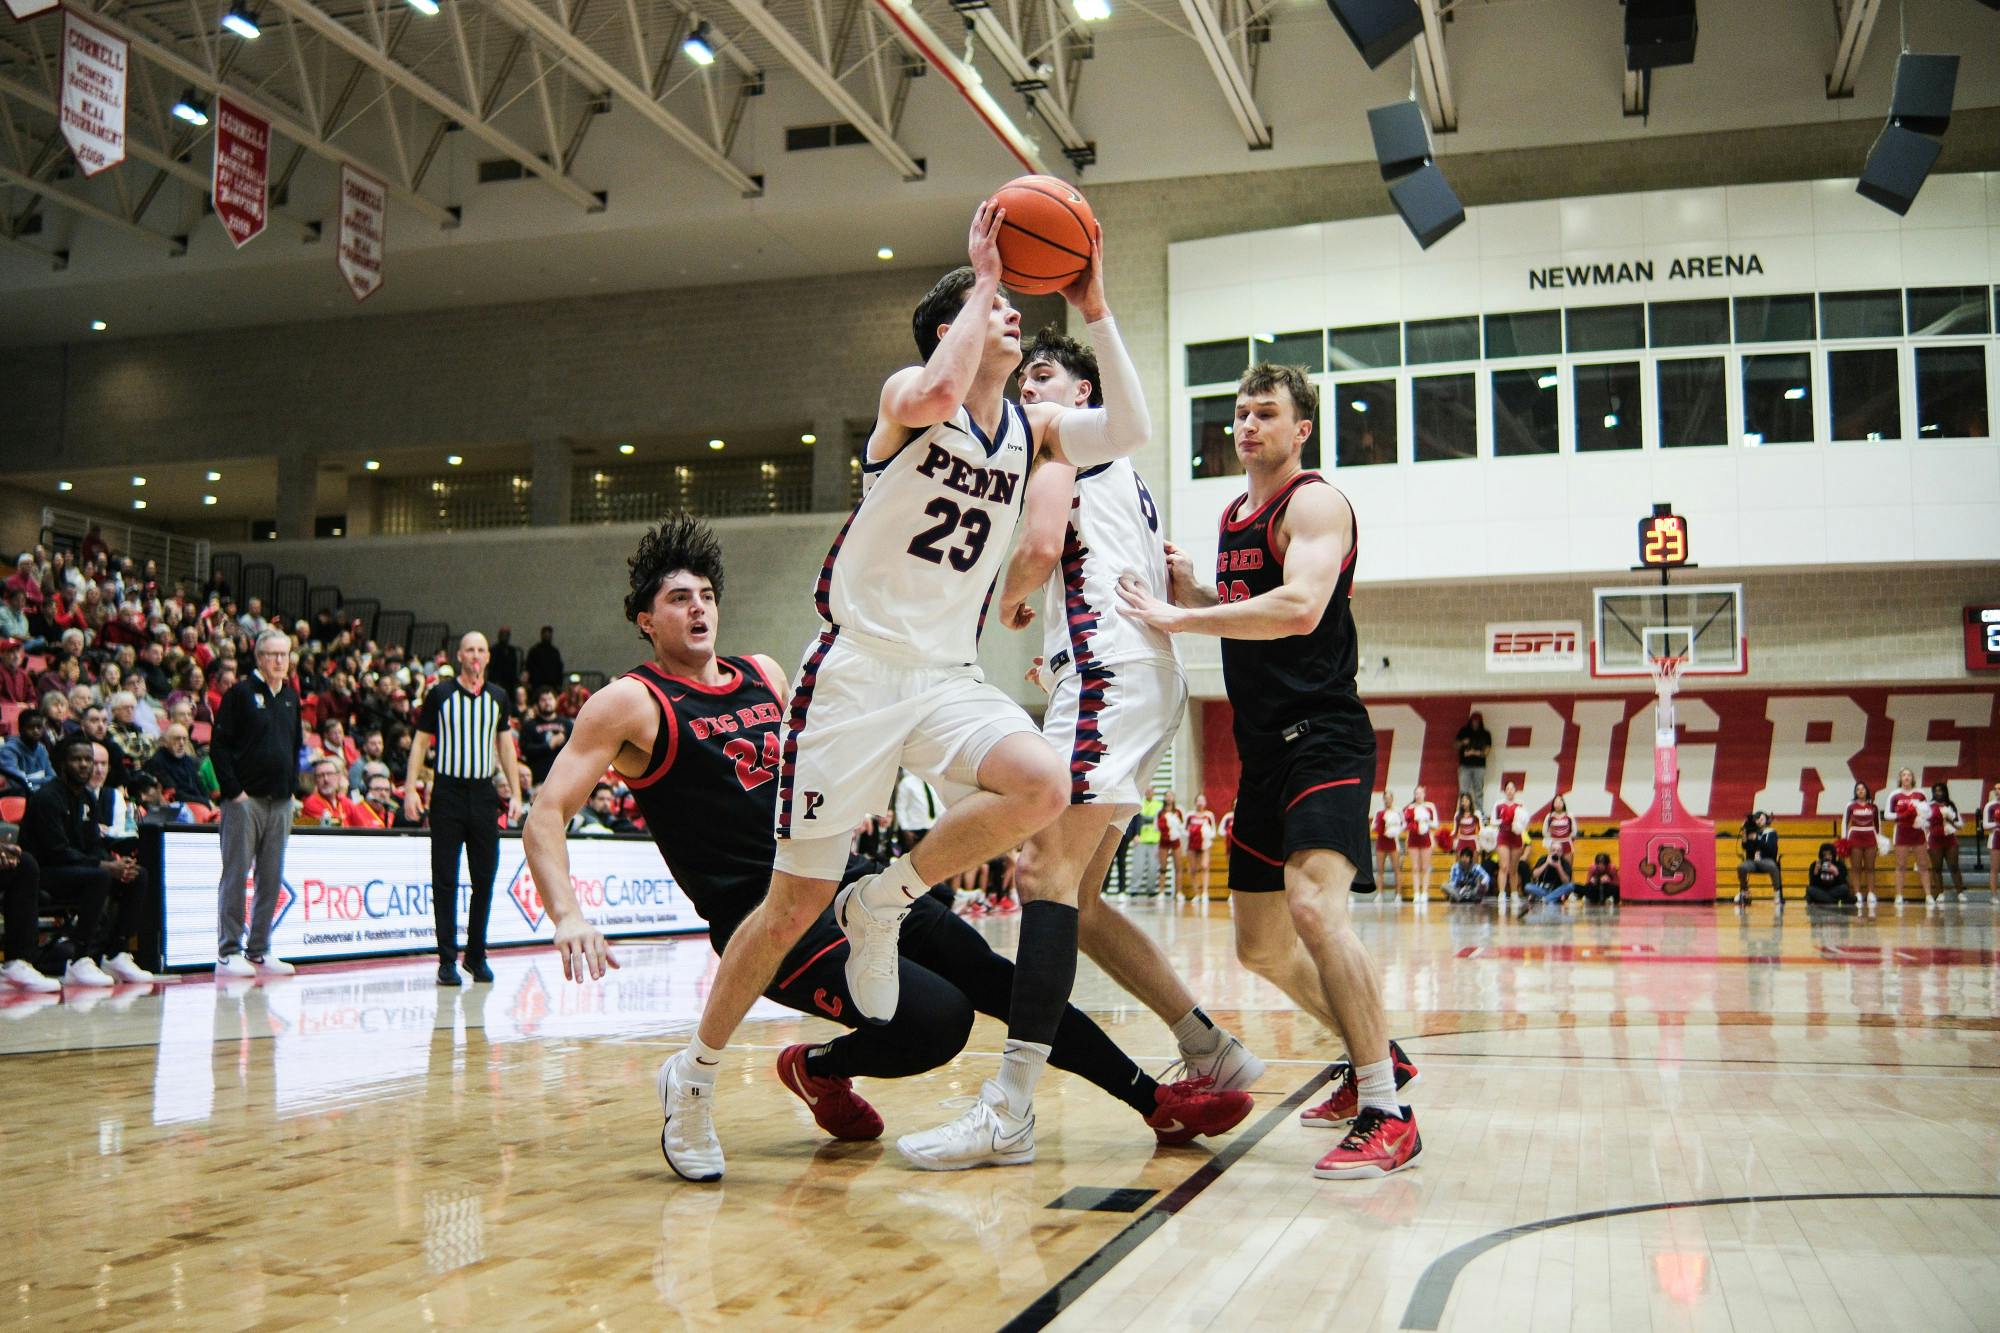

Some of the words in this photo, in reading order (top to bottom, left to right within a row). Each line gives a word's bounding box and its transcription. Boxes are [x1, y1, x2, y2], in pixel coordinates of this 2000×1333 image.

[69, 28, 123, 71] CORNELL
[220, 110, 266, 151] CORNELL
[1529, 261, 1654, 290] NEWMAN
[1668, 254, 1764, 280] ARENA
[916, 442, 1019, 505] PENN
[907, 497, 991, 573] 23
[1646, 530, 1682, 562] 23
[1229, 548, 1264, 571] RED
[1493, 632, 1575, 653] ESPN
[688, 714, 738, 740] BIG
[736, 703, 781, 728] RED
[1456, 697, 1720, 818] BIG
[803, 791, 824, 820] P
[814, 987, 843, 1017] C
